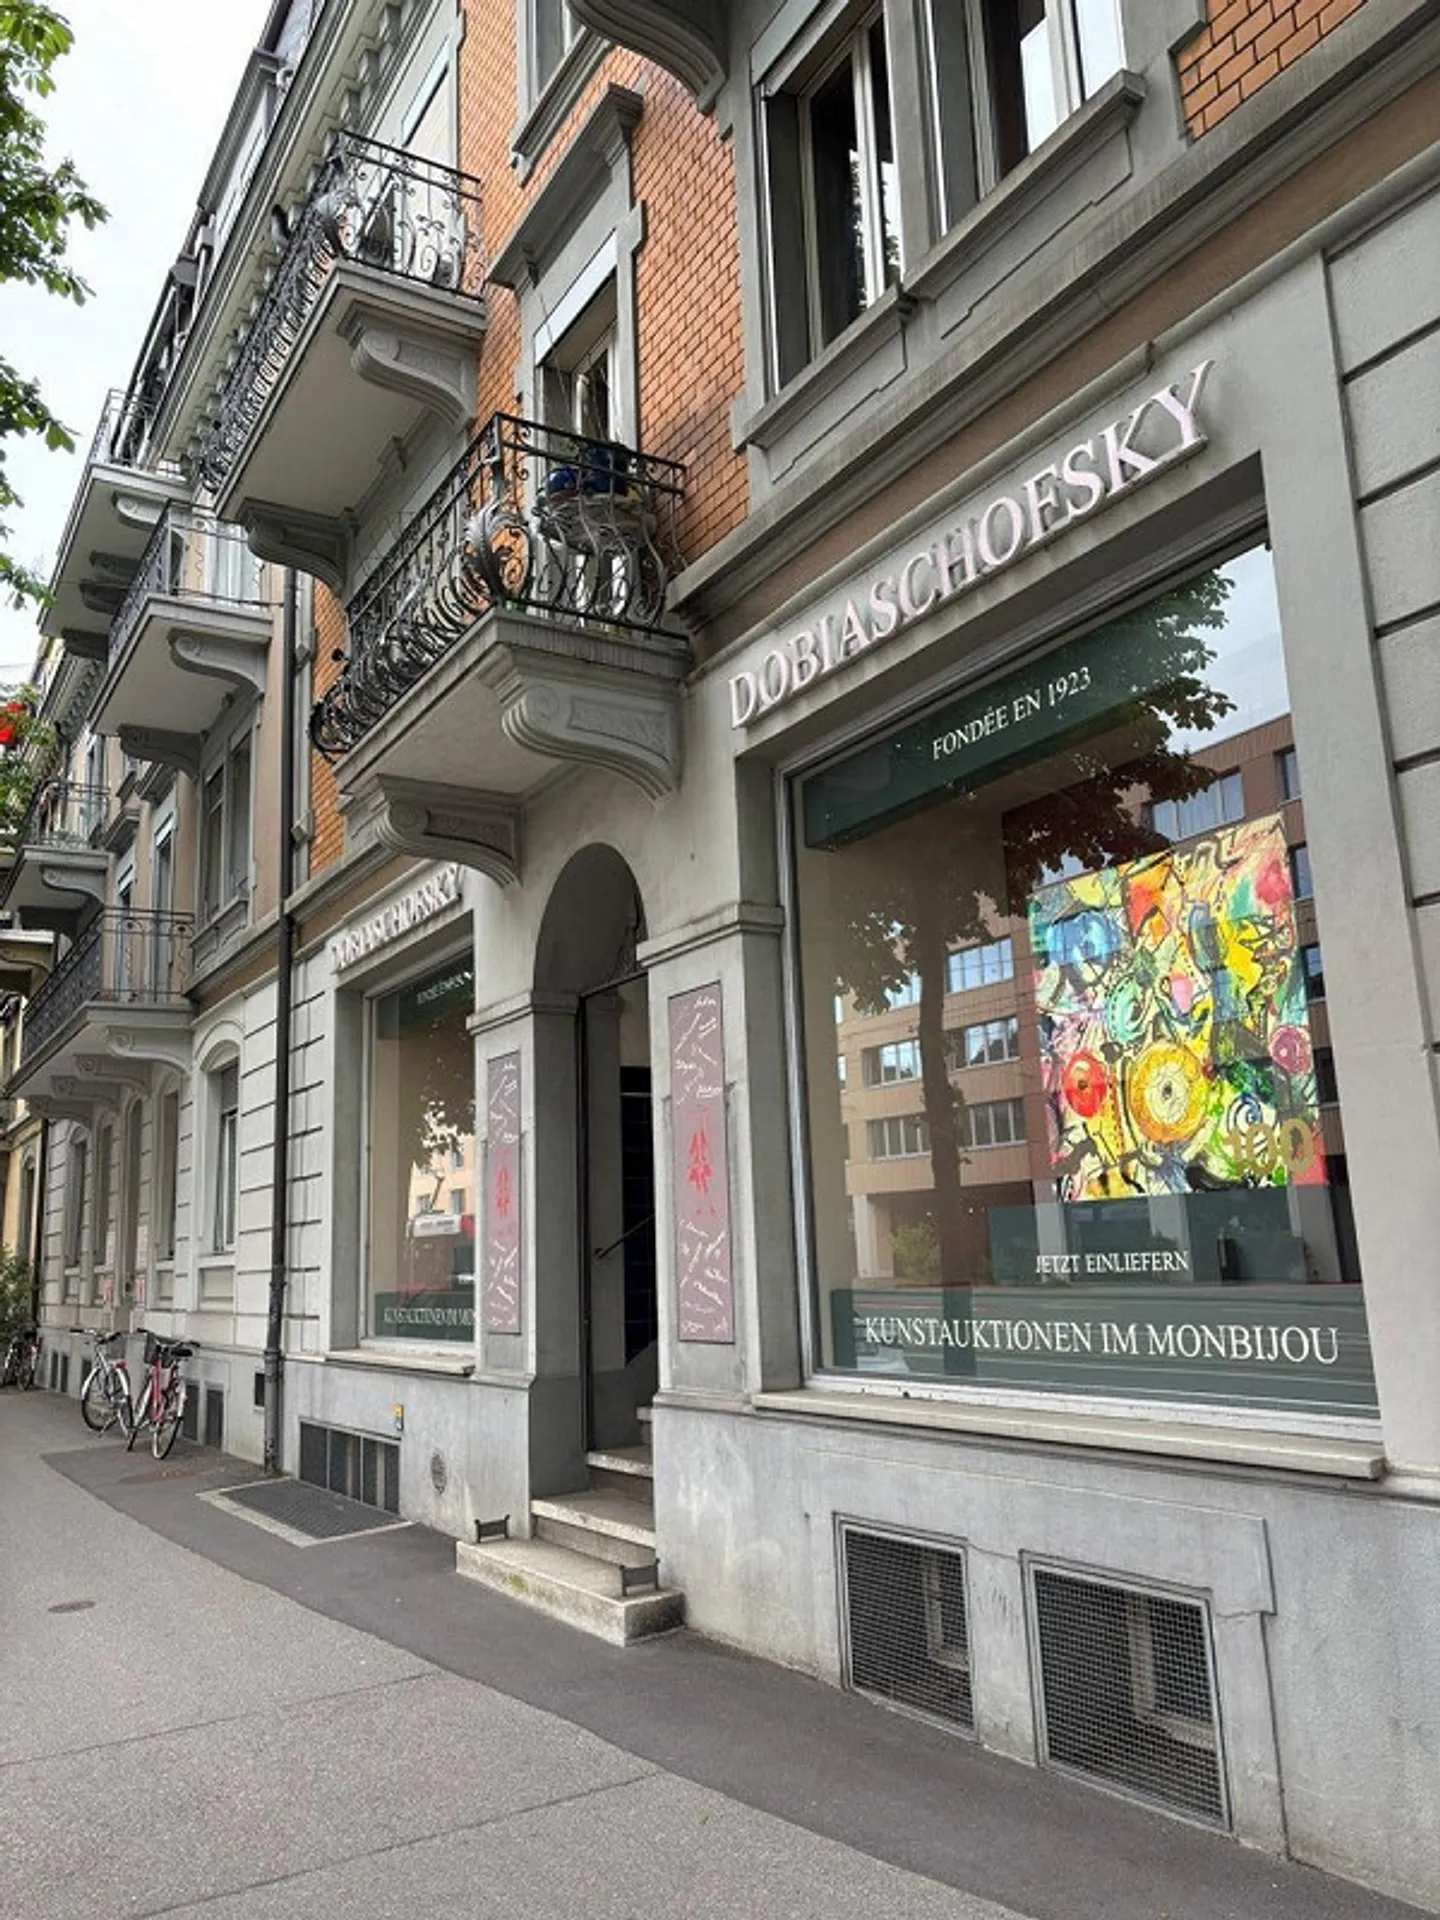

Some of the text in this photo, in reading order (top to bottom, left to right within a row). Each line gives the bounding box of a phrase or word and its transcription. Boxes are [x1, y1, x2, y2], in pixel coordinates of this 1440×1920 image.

[727, 359, 1217, 730] DOBIASCHOFSKY
[932, 666, 1092, 761] FONDÉE EN 1923
[1225, 1117, 1313, 1178] 100
[1035, 1249, 1190, 1275] JETZT EINLIEFERN
[864, 1316, 1339, 1365] KUNSTAUKTIONEN IM MONBIJOU
